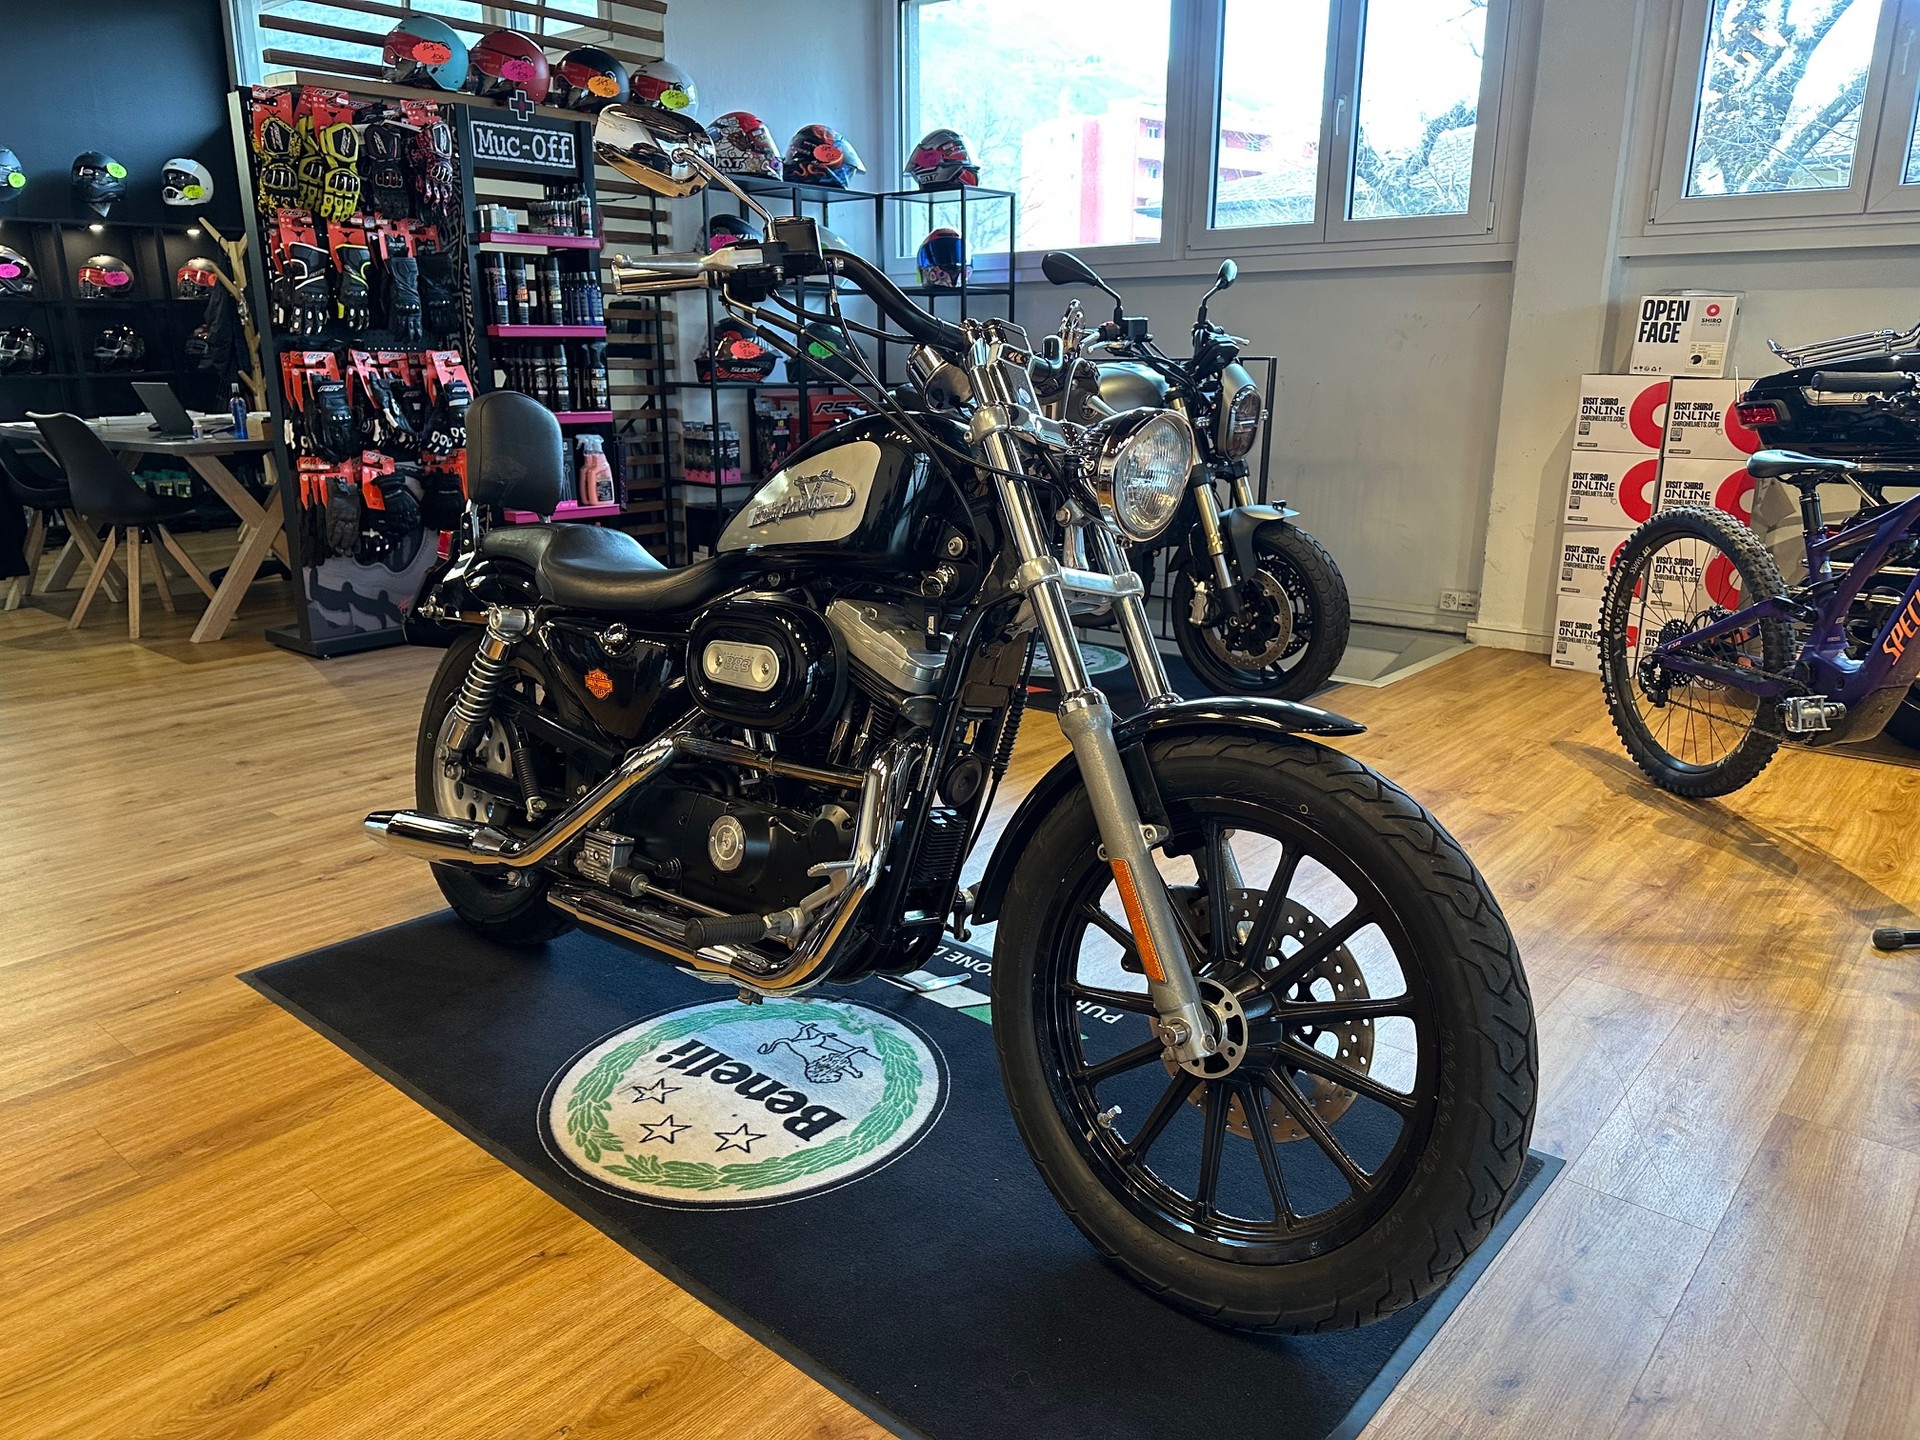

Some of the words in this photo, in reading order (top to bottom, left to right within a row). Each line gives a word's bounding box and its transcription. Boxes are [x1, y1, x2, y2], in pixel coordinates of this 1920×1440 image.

[476, 127, 570, 163] Muc-Off
[1641, 299, 1691, 322] OPEN
[1637, 321, 1682, 343] FACE
[1582, 397, 1599, 405] VISIT
[1599, 397, 1619, 406] SHIRO
[1674, 402, 1691, 410] VISIT
[1692, 402, 1713, 411] SHIRO
[813, 401, 867, 416] RST
[1581, 405, 1625, 416] ONLINE
[1673, 410, 1721, 421] ONLINE
[1572, 472, 1589, 481] VISIT
[1589, 473, 1608, 481] SHIRO
[1571, 480, 1615, 491] ONLINE
[1665, 480, 1683, 489] VISIT
[1683, 481, 1704, 490] SHIRO
[1664, 488, 1711, 500] ONLINE
[1565, 544, 1581, 552] VISIT
[1581, 545, 1600, 555] SHIRO
[1564, 553, 1606, 565] ONLINE
[1655, 555, 1672, 565] VISIT
[1673, 556, 1694, 567] SHIRO
[1655, 564, 1701, 577] ONLINE
[1603, 568, 1624, 632] MICHELIN
[1559, 620, 1574, 628] VISIT
[1574, 621, 1593, 631] SHIRO
[1882, 588, 1920, 666] SPEC
[1603, 636, 1611, 660] REAR
[1075, 999, 1124, 1025] PUR
[656, 1038, 847, 1142] Benelli
